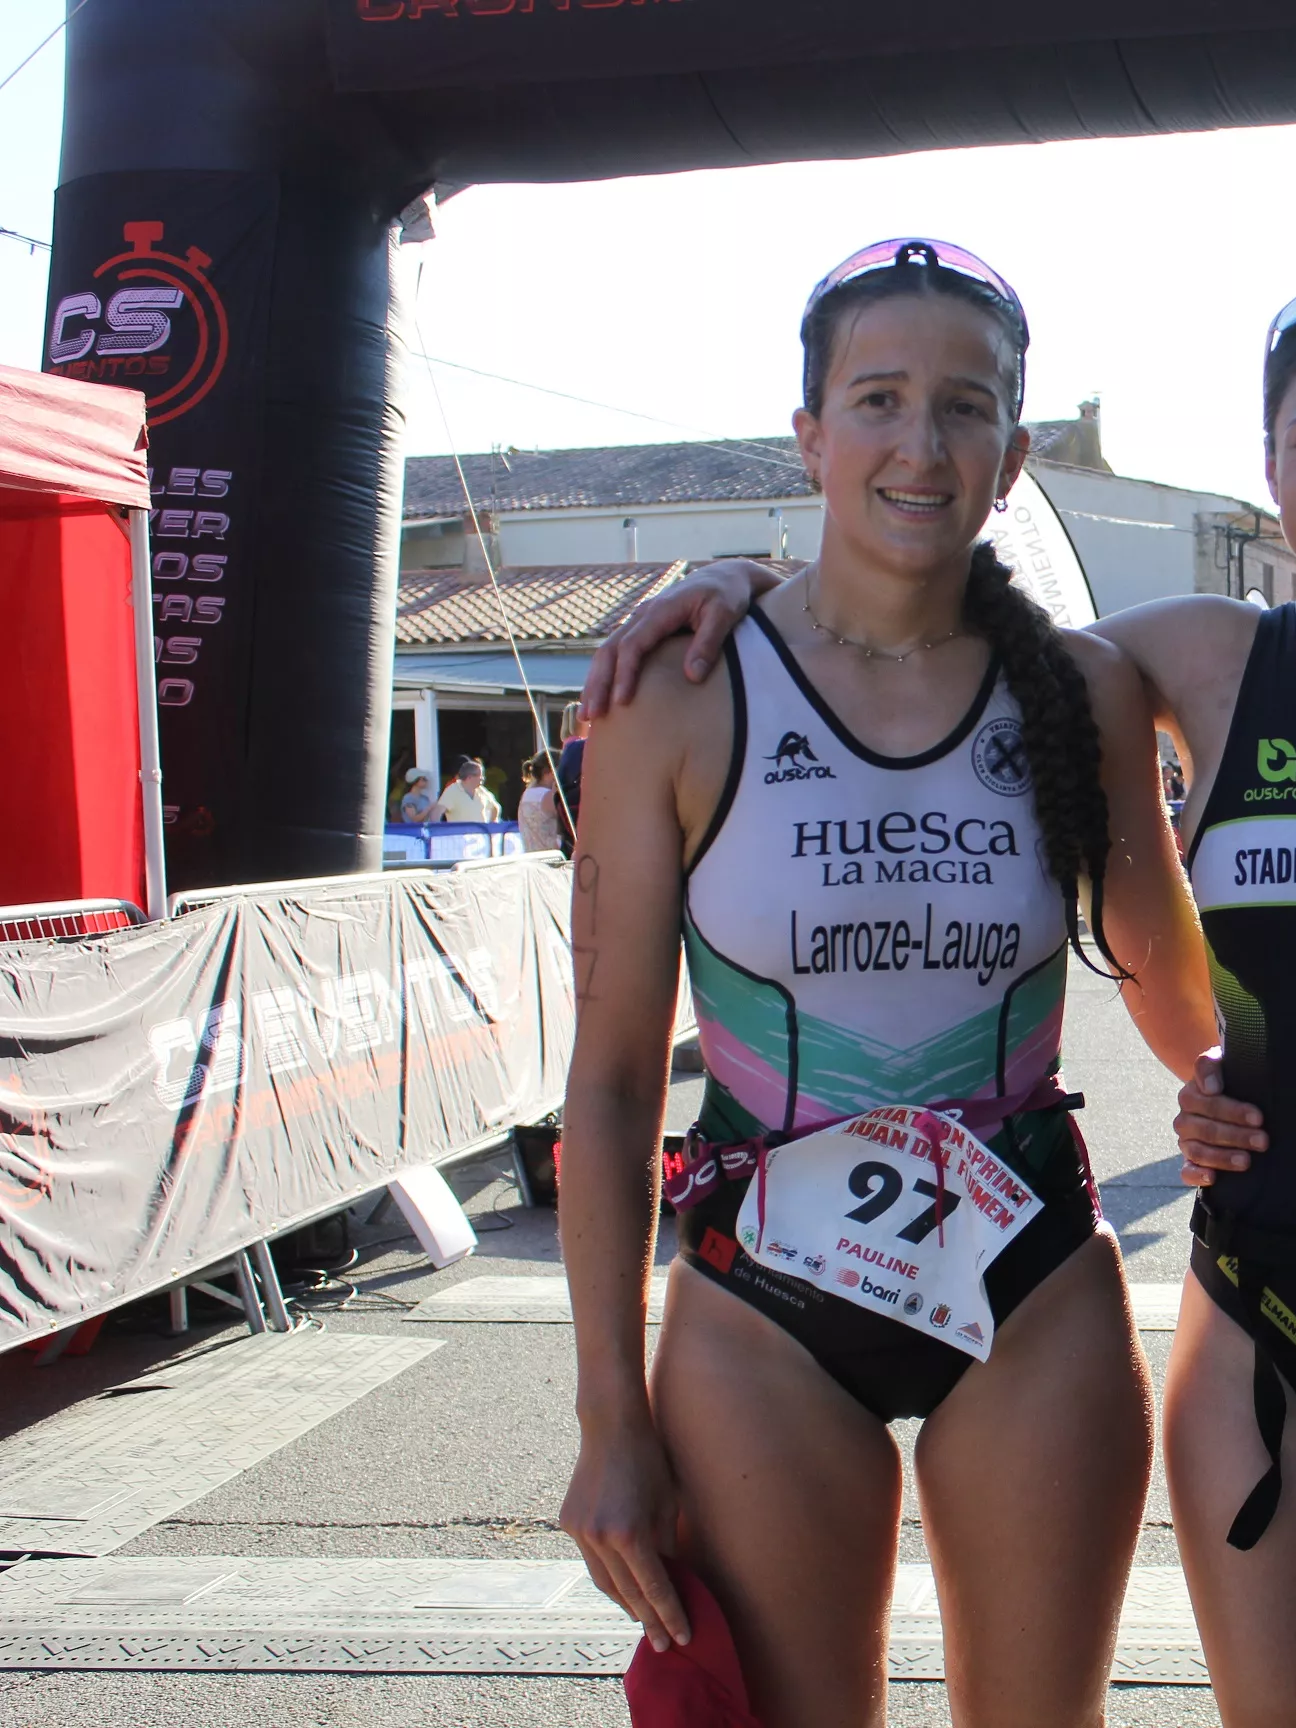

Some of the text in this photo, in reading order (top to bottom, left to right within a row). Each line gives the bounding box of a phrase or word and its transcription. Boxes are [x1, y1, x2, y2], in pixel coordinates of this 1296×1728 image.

[50, 287, 184, 364] CS
[764, 763, 837, 785] austral
[790, 903, 1021, 987] Larroze-Lauga
[151, 998, 248, 1112] CS
[251, 946, 501, 1074] EVENTOS
[844, 1160, 962, 1245] 97
[734, 1267, 806, 1310] de Huesca
[836, 1237, 920, 1280] PAULINE
[861, 1276, 901, 1305] barri
